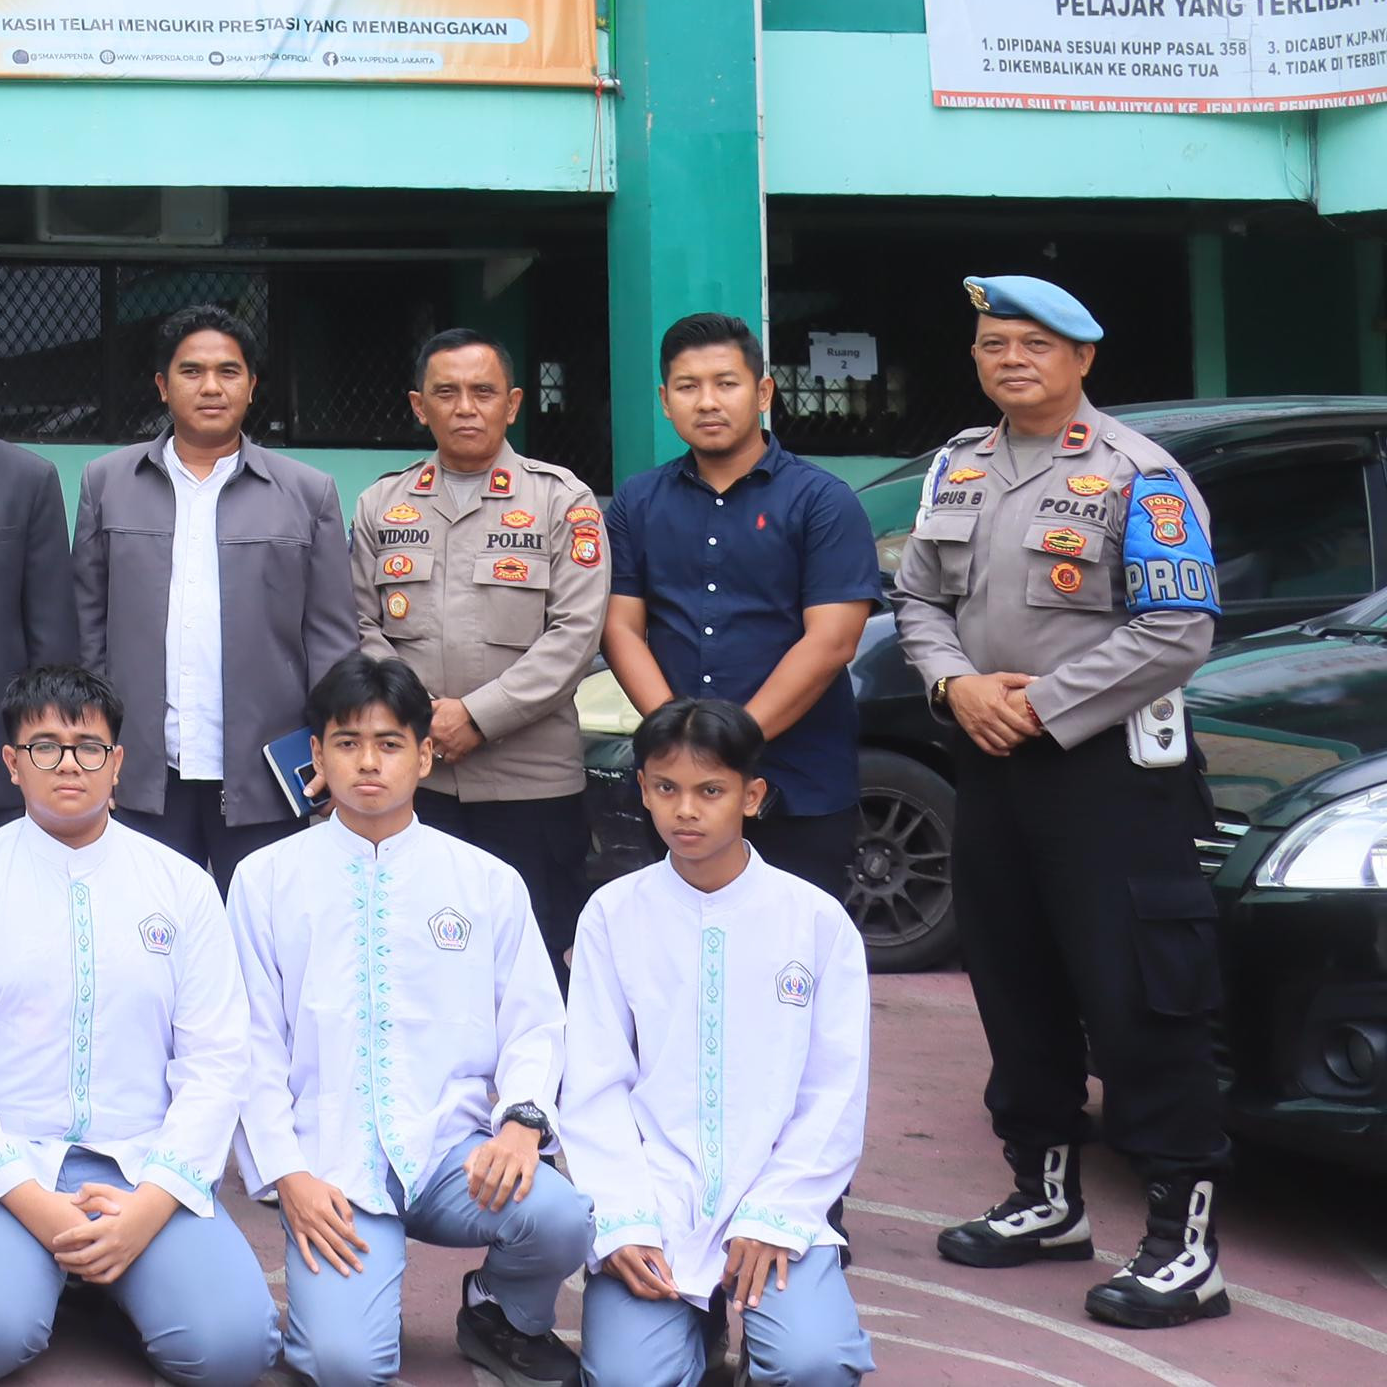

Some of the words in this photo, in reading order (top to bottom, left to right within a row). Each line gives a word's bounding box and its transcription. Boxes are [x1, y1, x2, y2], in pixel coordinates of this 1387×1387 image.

[2, 18, 55, 31] KASIH
[60, 18, 113, 31] TELAH
[119, 19, 214, 32] MENGUKIR
[219, 17, 300, 33] PRESTASI
[304, 20, 347, 33] YANG
[353, 21, 507, 35] MEMBANGGAKAN
[982, 38, 993, 51] 1.
[997, 38, 1062, 54] DIPIDANA
[1067, 41, 1116, 54] SESUAI
[1121, 41, 1162, 55] KUHP
[1167, 42, 1214, 55] PASAL
[1220, 42, 1247, 55] 358
[1268, 41, 1280, 54] 3.
[1285, 34, 1342, 53] DICABUT
[1346, 28, 1387, 47] KJP-NY
[983, 59, 995, 72] 2.
[999, 59, 1103, 75] DIKEMBALIKAN
[1108, 63, 1127, 76] KE
[1132, 64, 1183, 77] ORANG
[1189, 65, 1219, 77] TUA
[1268, 63, 1281, 75] 4.
[1286, 59, 1327, 74] TIDAK
[1331, 57, 1343, 70] DI
[827, 348, 860, 358] Ruang
[841, 360, 847, 369] 2
[1039, 497, 1106, 521] POLRI
[1148, 496, 1181, 508] POLDA
[378, 529, 430, 545] WIDODO
[486, 532, 543, 550] POLRI
